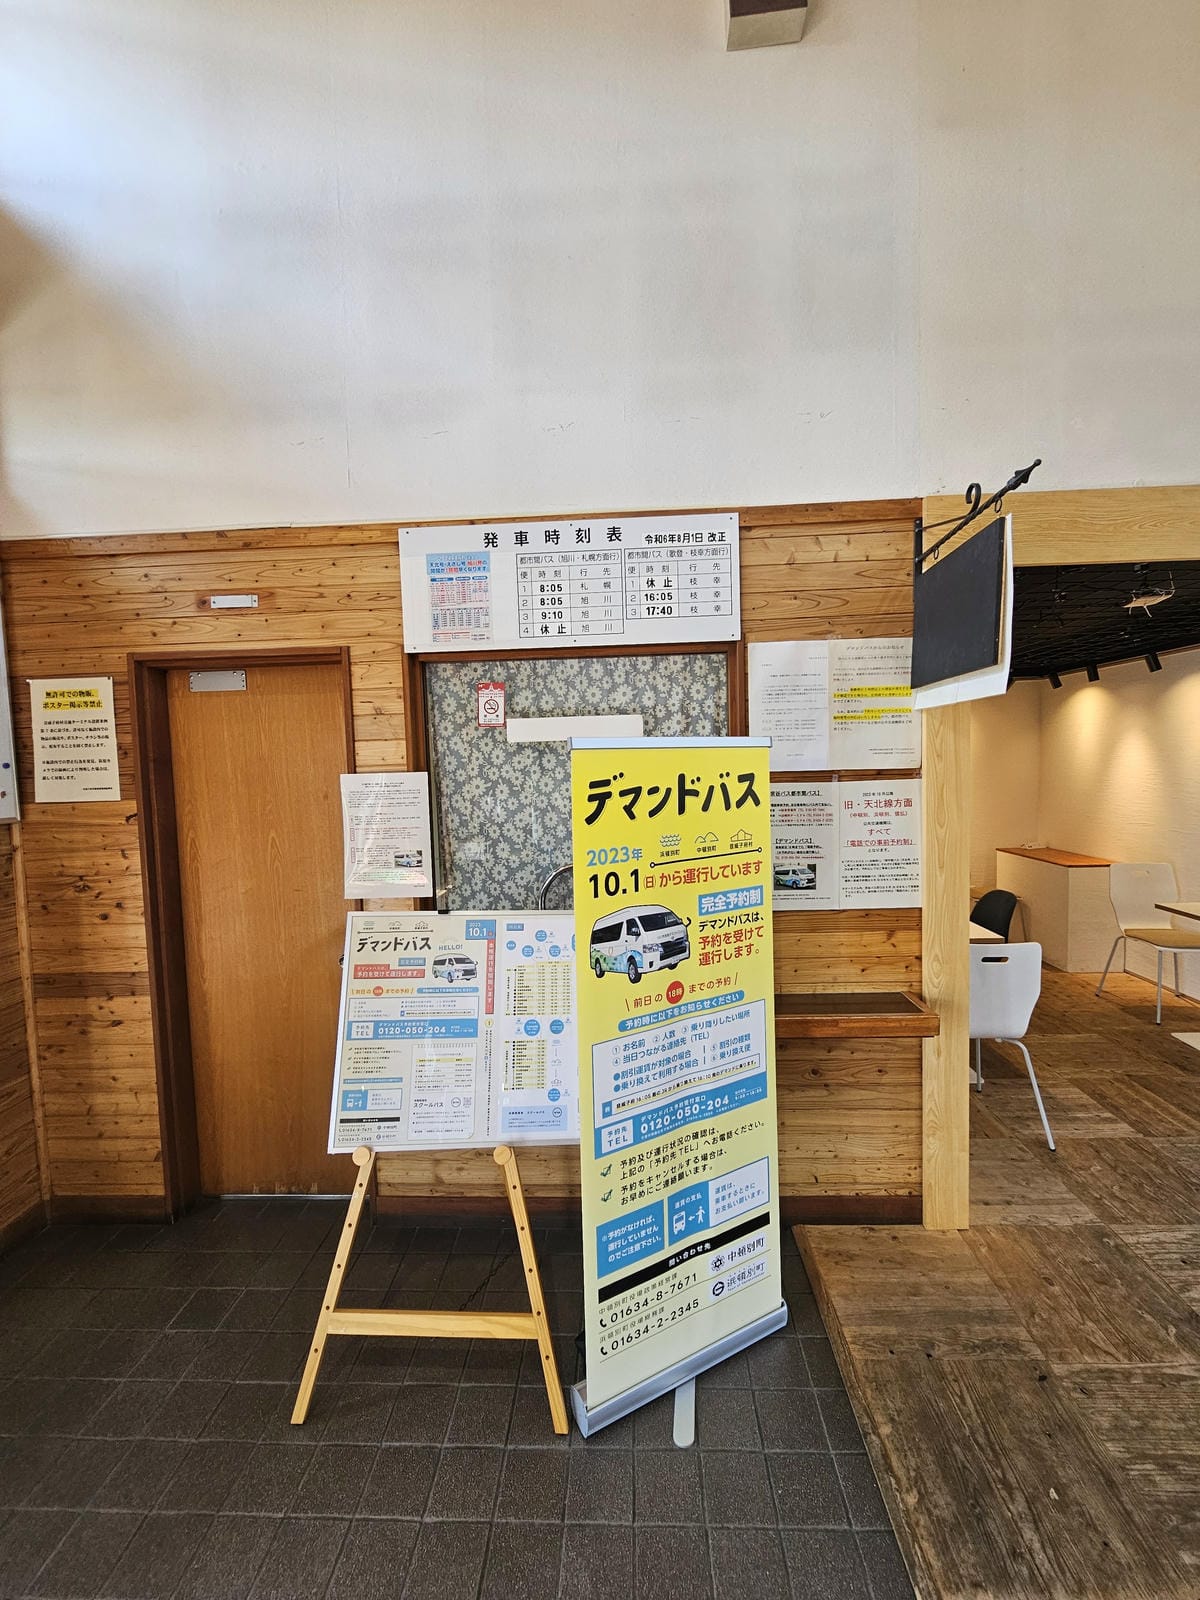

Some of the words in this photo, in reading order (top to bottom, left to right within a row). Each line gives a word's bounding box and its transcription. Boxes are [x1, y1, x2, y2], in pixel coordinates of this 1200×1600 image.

[483, 526, 623, 548] 発車時刻表
[520, 571, 528, 579] 便
[627, 566, 636, 574] 便
[539, 583, 563, 593] 8:05
[631, 580, 635, 588] 1
[540, 597, 563, 606] 8:05
[644, 592, 673, 601] 16:05
[541, 610, 563, 620] 9:10
[630, 608, 637, 616] 3
[645, 605, 673, 616] 17:40
[584, 771, 761, 825] デマンドバス
[844, 798, 913, 810] 旧・天北線方面
[867, 828, 891, 836] すべて
[586, 846, 643, 867] 2023年
[659, 860, 763, 888] から運行しています
[701, 888, 762, 913] 完全予約制
[698, 912, 764, 932] デマンドバスは、
[356, 935, 432, 953] デマンドバス
[698, 926, 765, 951] 予約を受けて
[698, 943, 760, 967] 運行します。
[625, 994, 740, 1031] 予約時に以下をお知らせください
[378, 1026, 446, 1035] 0120-050-204
[640, 1095, 730, 1134] 0120-050-204
[607, 1136, 629, 1147] TEL
[607, 1225, 659, 1252] 運行していません
[668, 1242, 711, 1268] 問い合わせ先
[727, 1236, 764, 1262] 中頓別町
[610, 1272, 698, 1323] 01634-8-7671
[611, 1298, 700, 1351] 01634-2-2345
